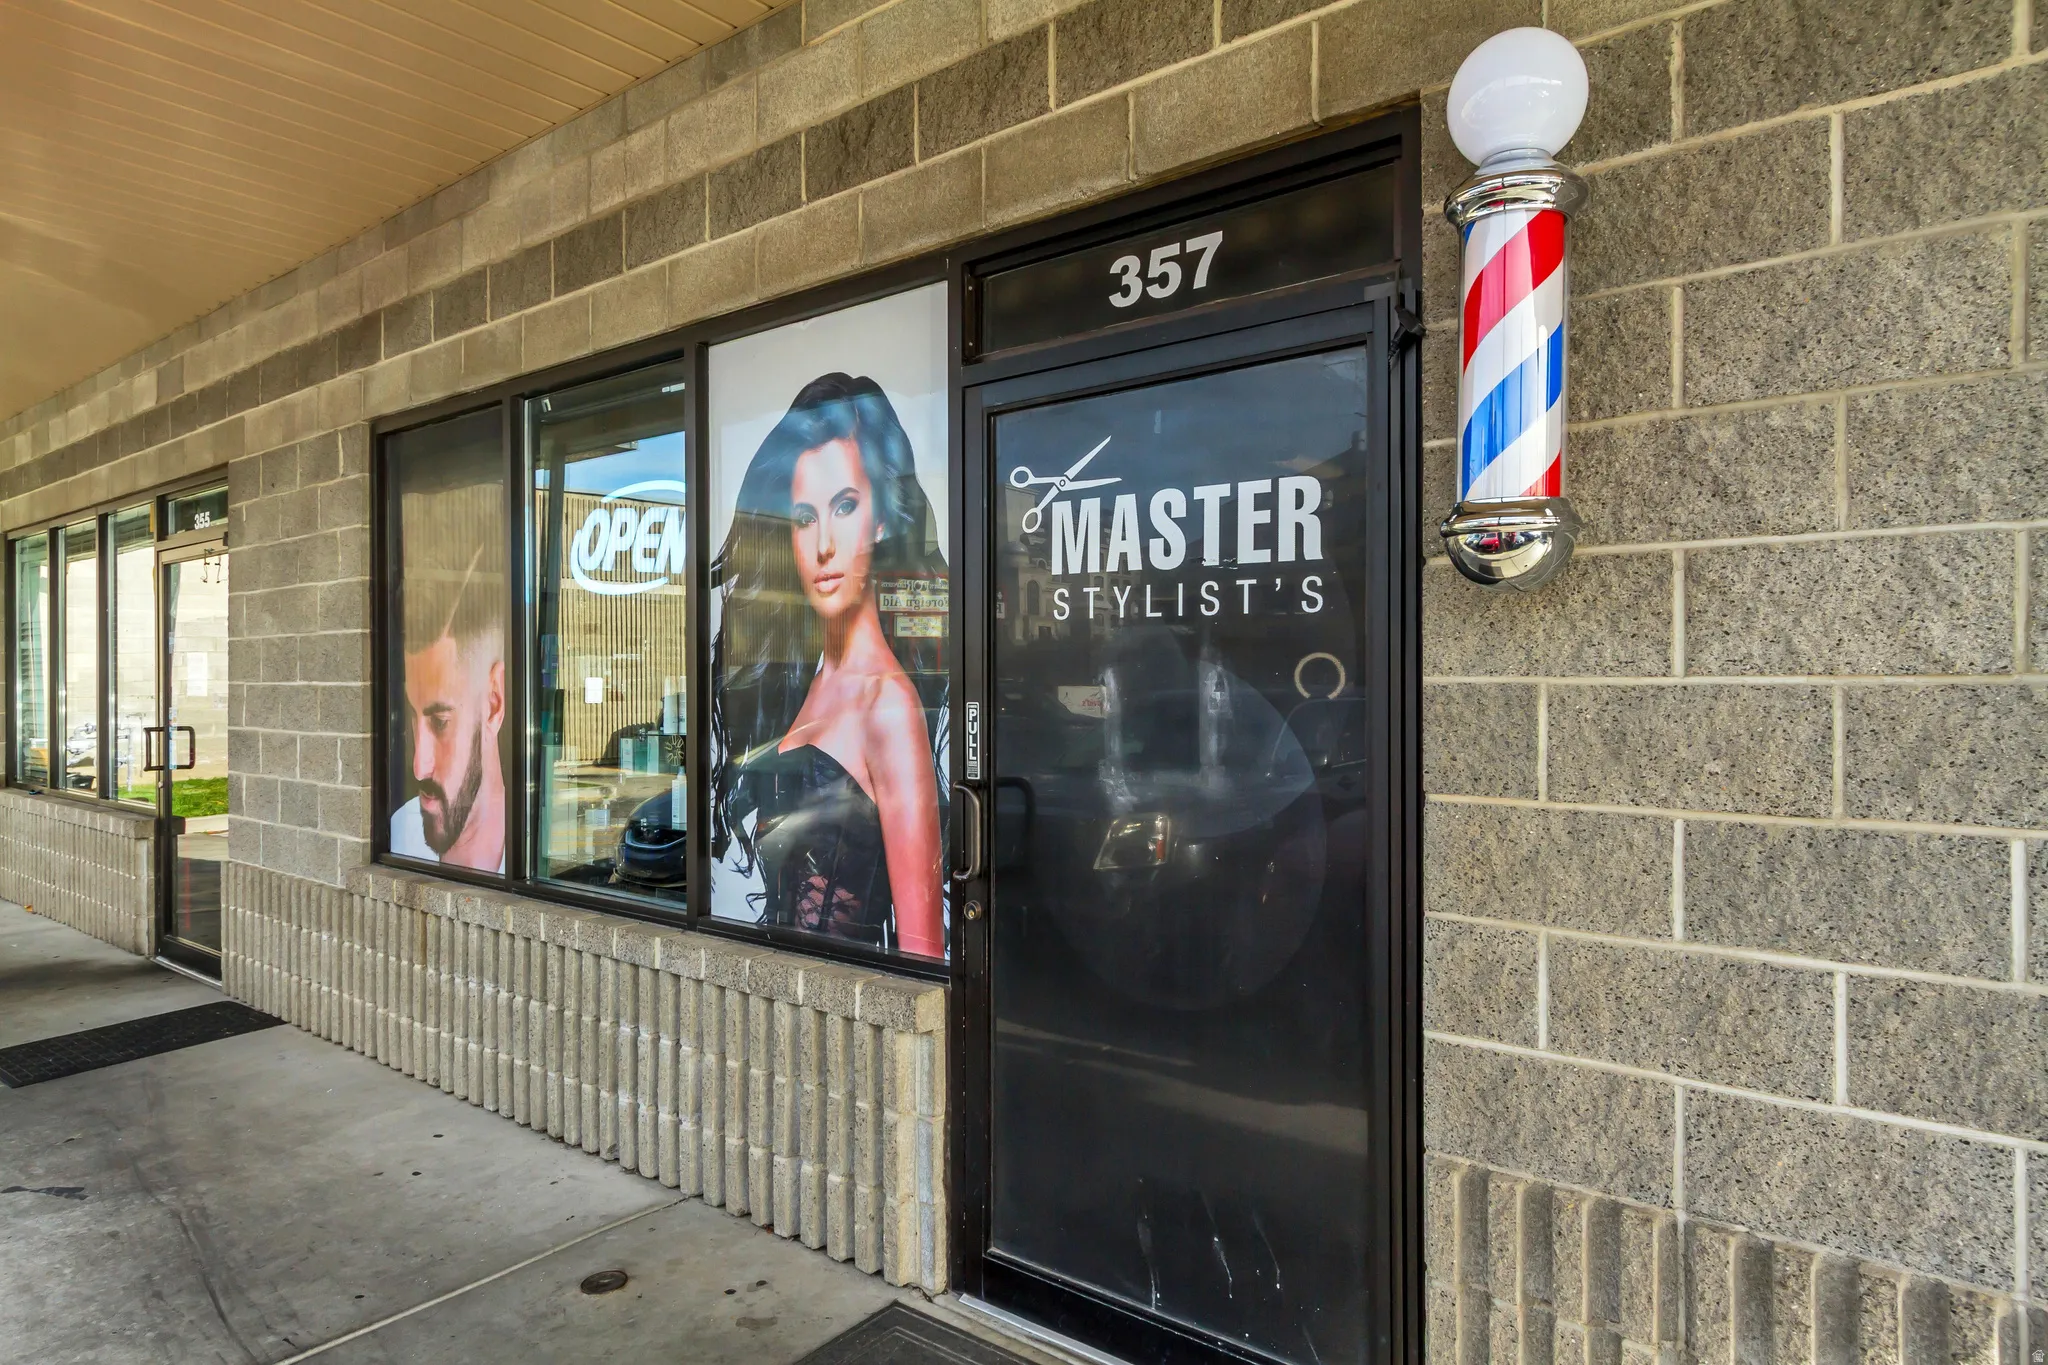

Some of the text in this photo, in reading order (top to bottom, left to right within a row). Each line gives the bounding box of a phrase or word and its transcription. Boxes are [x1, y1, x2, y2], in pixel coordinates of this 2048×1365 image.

[1109, 231, 1223, 308] 357
[194, 511, 211, 530] 355
[578, 507, 687, 574] OPEN
[1051, 475, 1323, 575] MASTER
[1052, 575, 1324, 621] STYLIST'S
[968, 708, 977, 760] PULL
